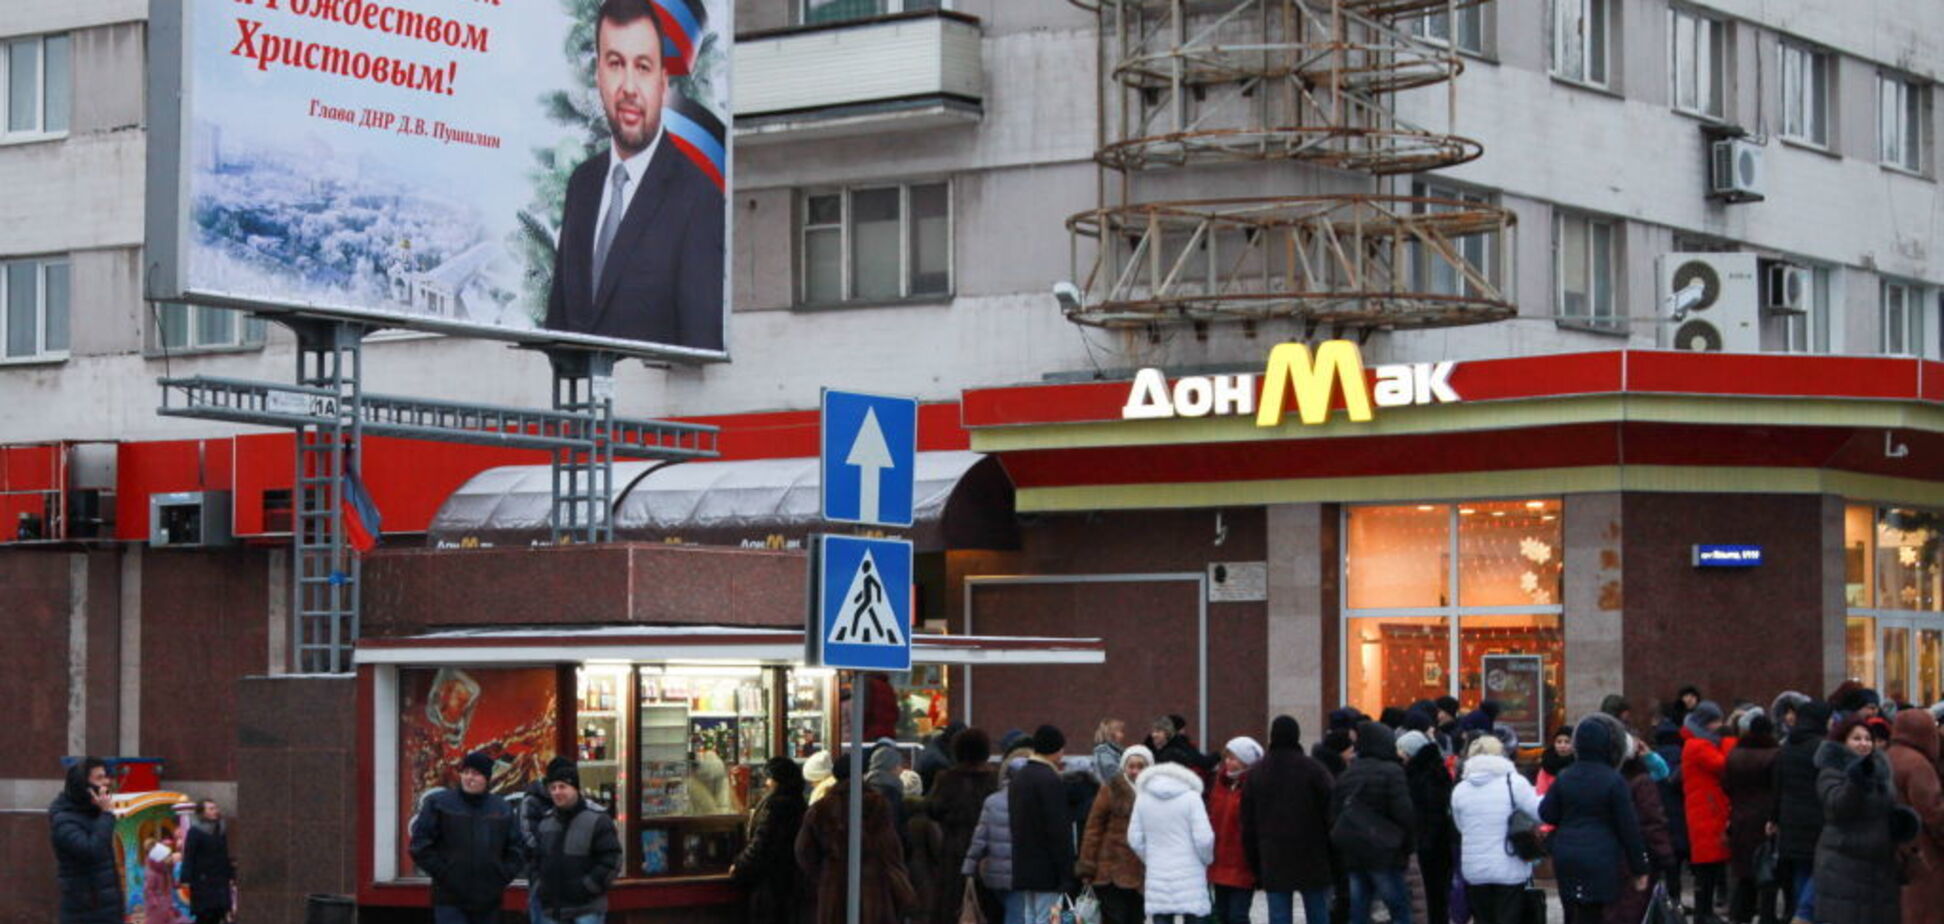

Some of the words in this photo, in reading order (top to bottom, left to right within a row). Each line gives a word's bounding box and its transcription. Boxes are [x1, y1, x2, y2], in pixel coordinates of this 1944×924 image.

[231, 18, 457, 96] Христовым!
[308, 98, 355, 123] Глава
[359, 108, 396, 130] ДНР
[397, 115, 428, 137] Д.В.
[1122, 339, 1462, 427] ДонМак
